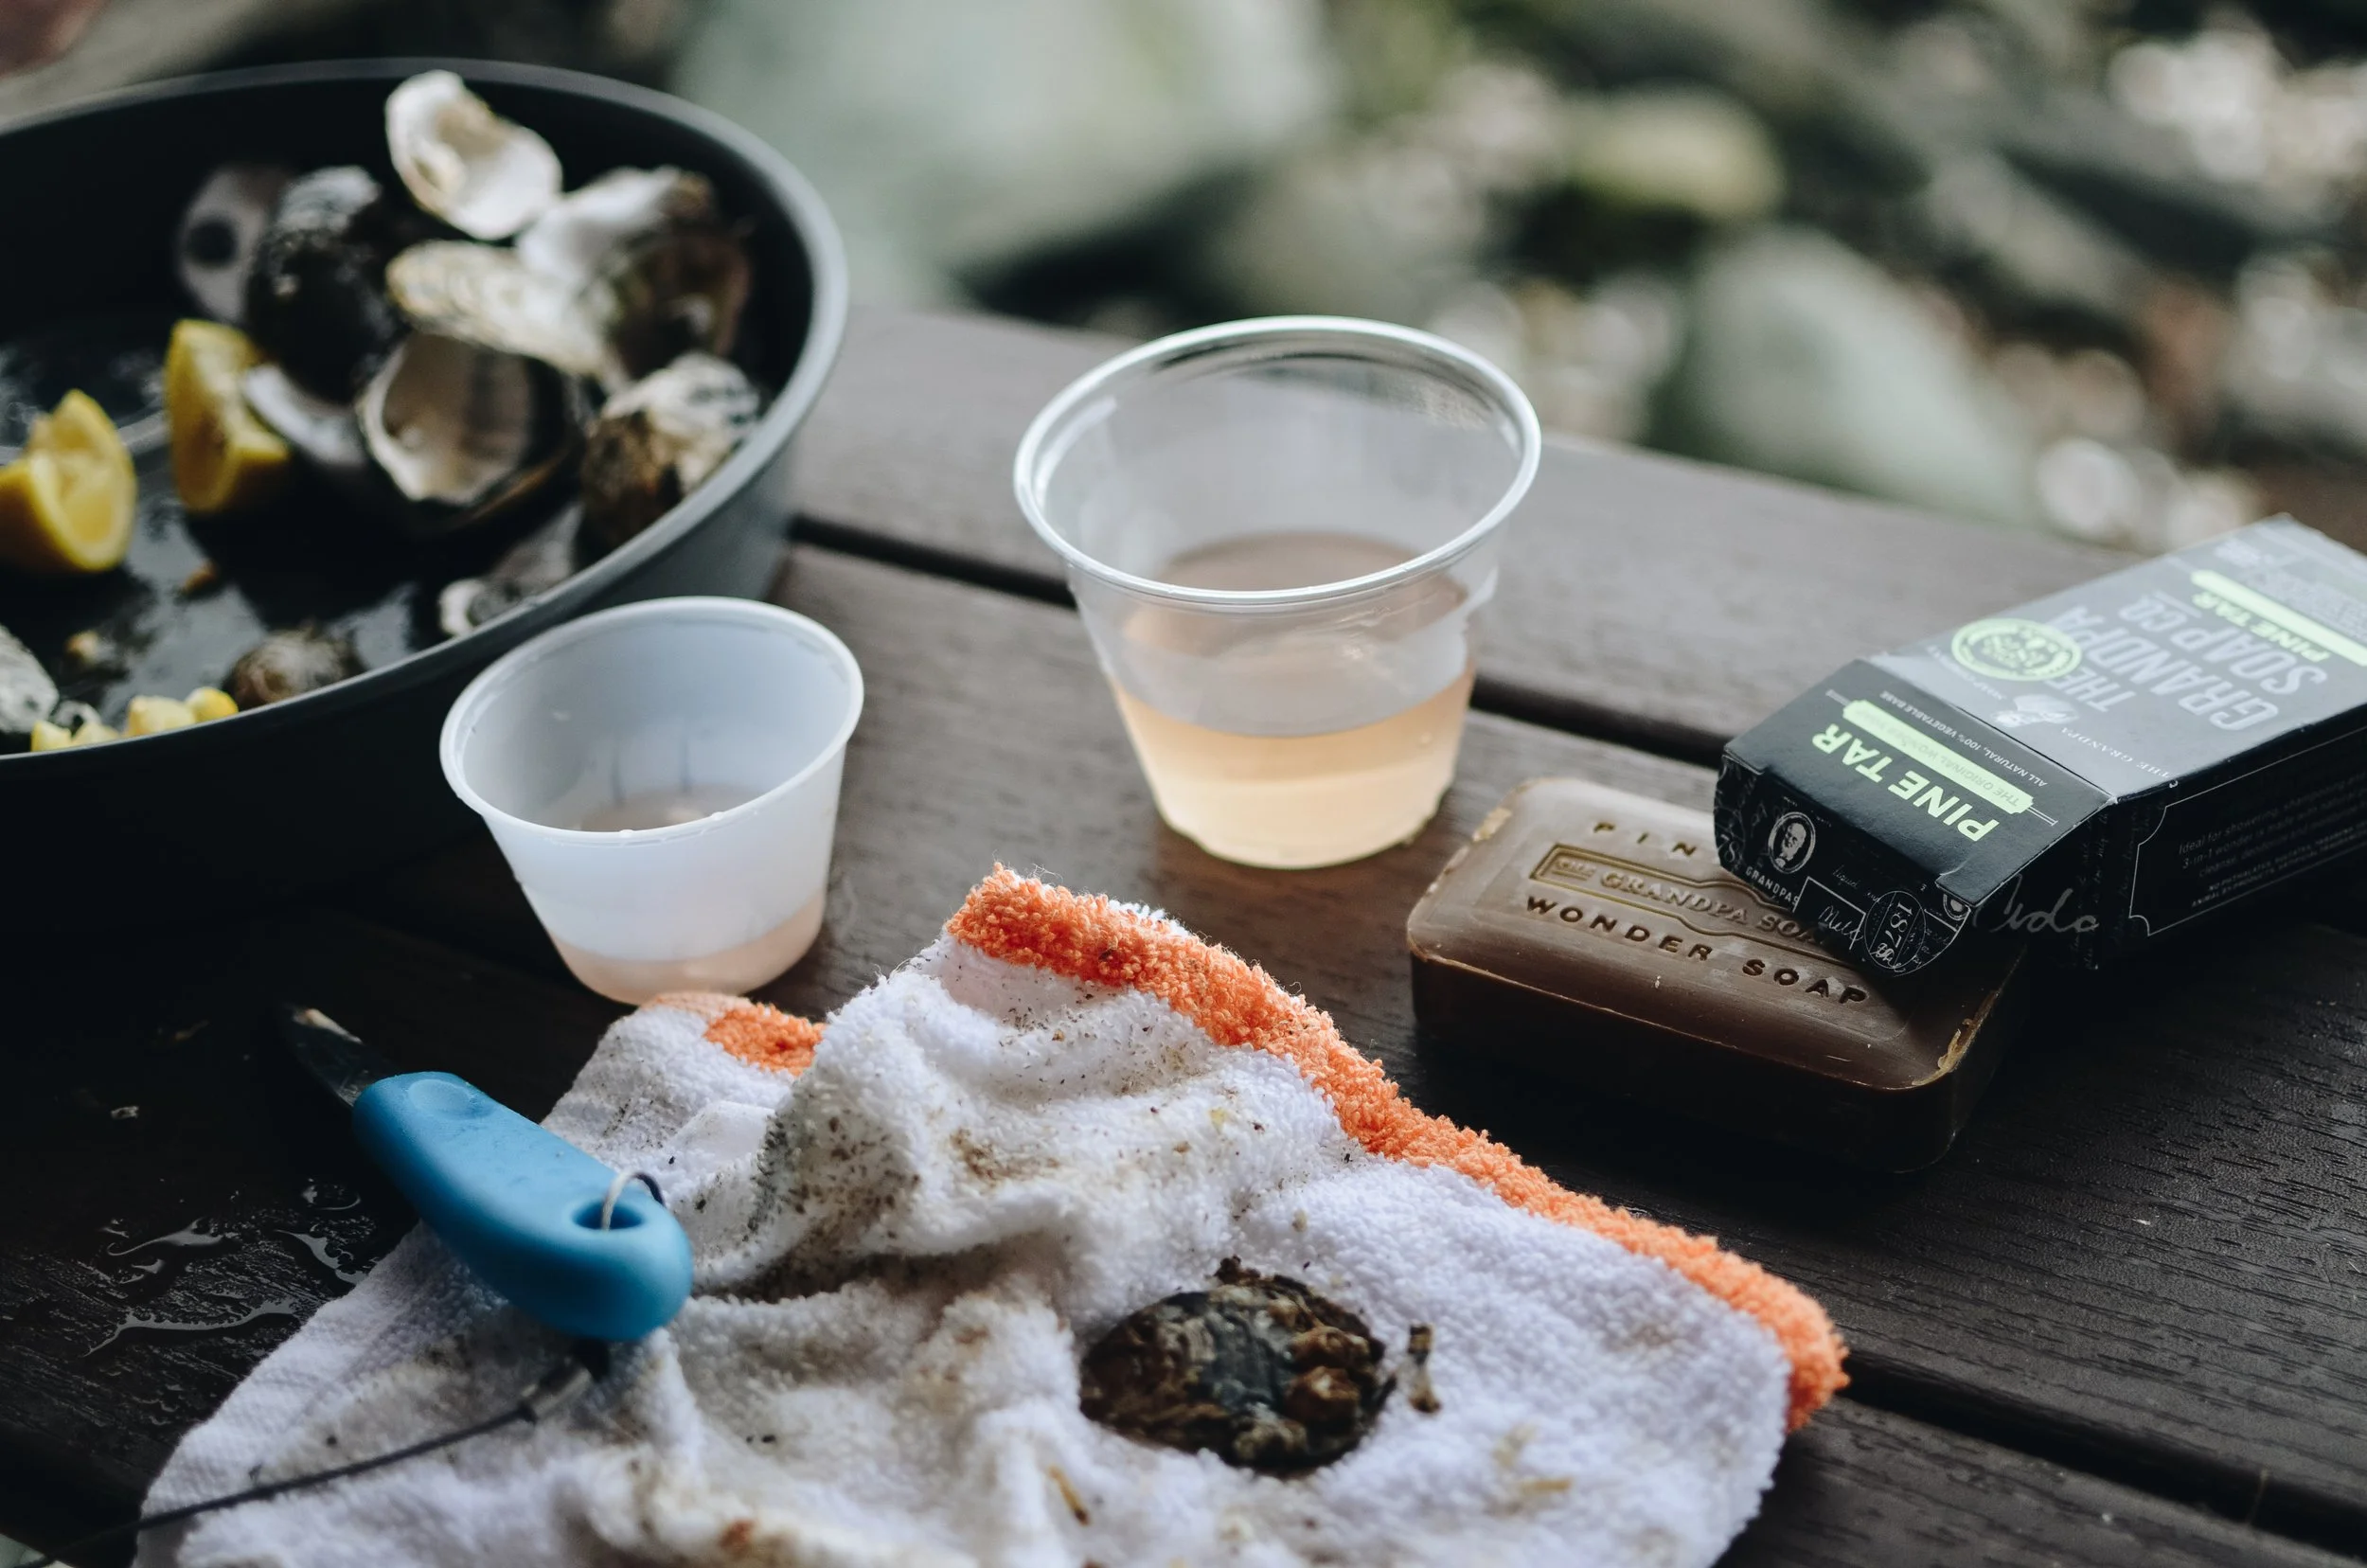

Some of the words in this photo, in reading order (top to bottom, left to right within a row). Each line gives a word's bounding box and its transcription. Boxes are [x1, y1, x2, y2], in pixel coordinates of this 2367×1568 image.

[2170, 625, 2328, 695] SOAP
[2248, 619, 2331, 663] PINE
[2036, 604, 2280, 731] GRANDPA
[2043, 663, 2137, 713] THE
[1904, 705, 1960, 742] VEGETABLE
[1957, 729, 1984, 752] 100%
[1811, 722, 1893, 783] TAR
[1981, 748, 2030, 778] NATURAL,
[2060, 726, 2135, 763] GRANDPA
[1939, 755, 1995, 793] ORIGINAL
[2023, 772, 2048, 788] ALL
[2136, 760, 2170, 779] THE
[1887, 770, 2000, 843] PINE
[1990, 783, 2020, 808] THE
[1599, 869, 1748, 928] GRANDPA
[1526, 895, 1713, 962] WONDER
[1741, 958, 1869, 1006] SOAP
